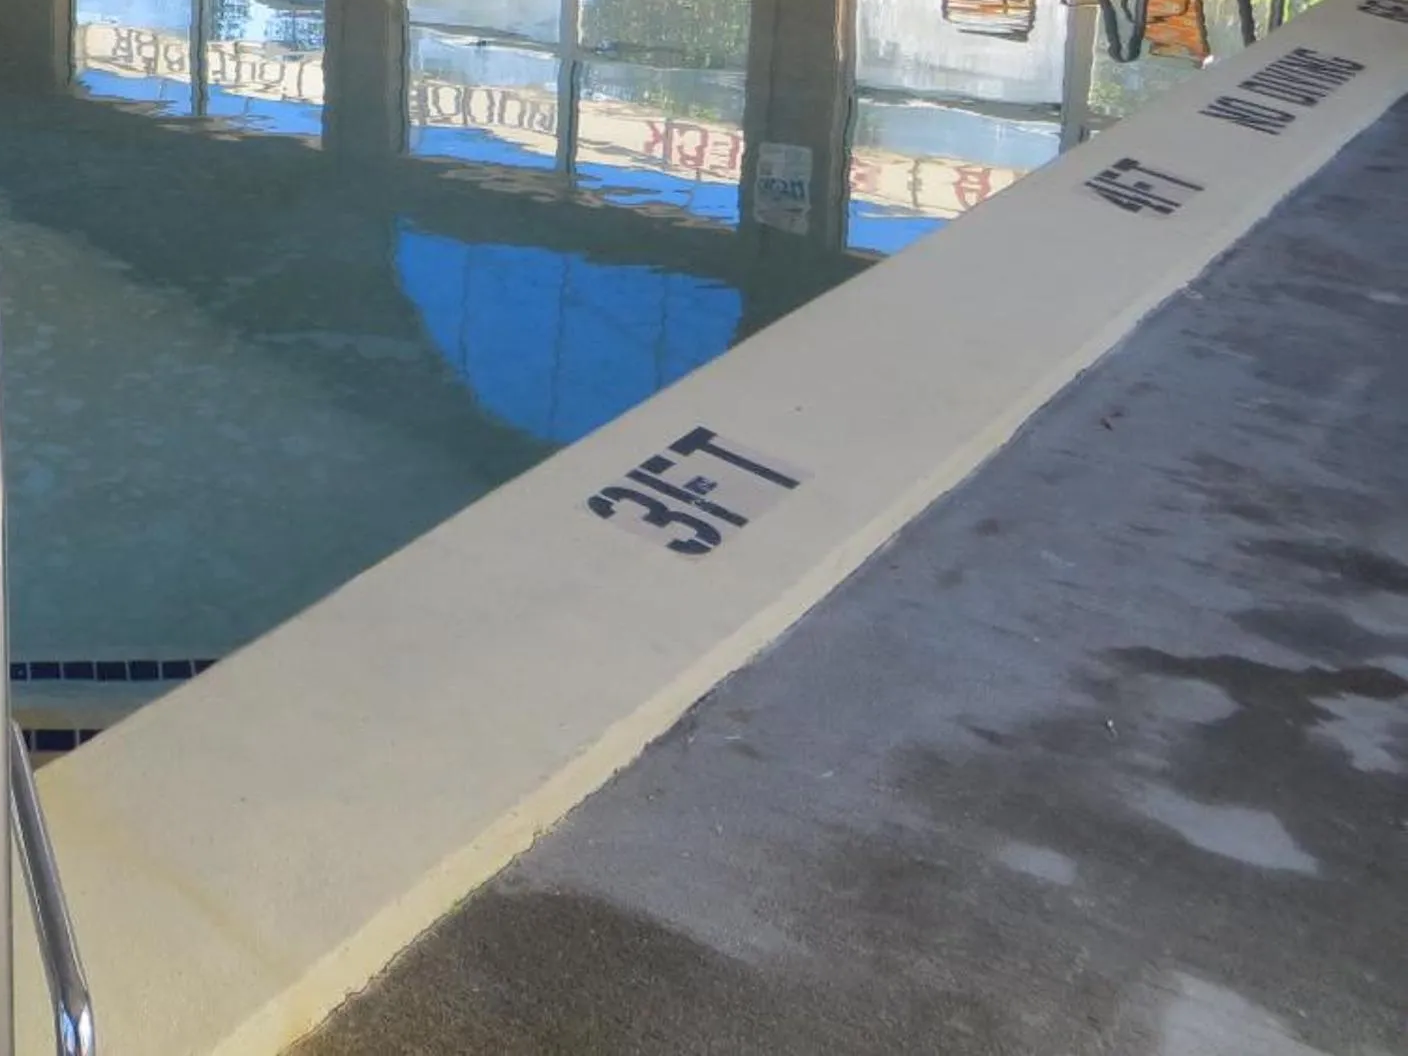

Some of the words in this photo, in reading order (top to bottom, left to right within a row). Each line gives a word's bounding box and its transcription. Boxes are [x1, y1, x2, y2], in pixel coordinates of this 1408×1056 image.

[1237, 47, 1366, 108] DIVING
[1198, 96, 1296, 136] NO
[1084, 157, 1205, 215] 4FT
[587, 426, 800, 555] 3FT
